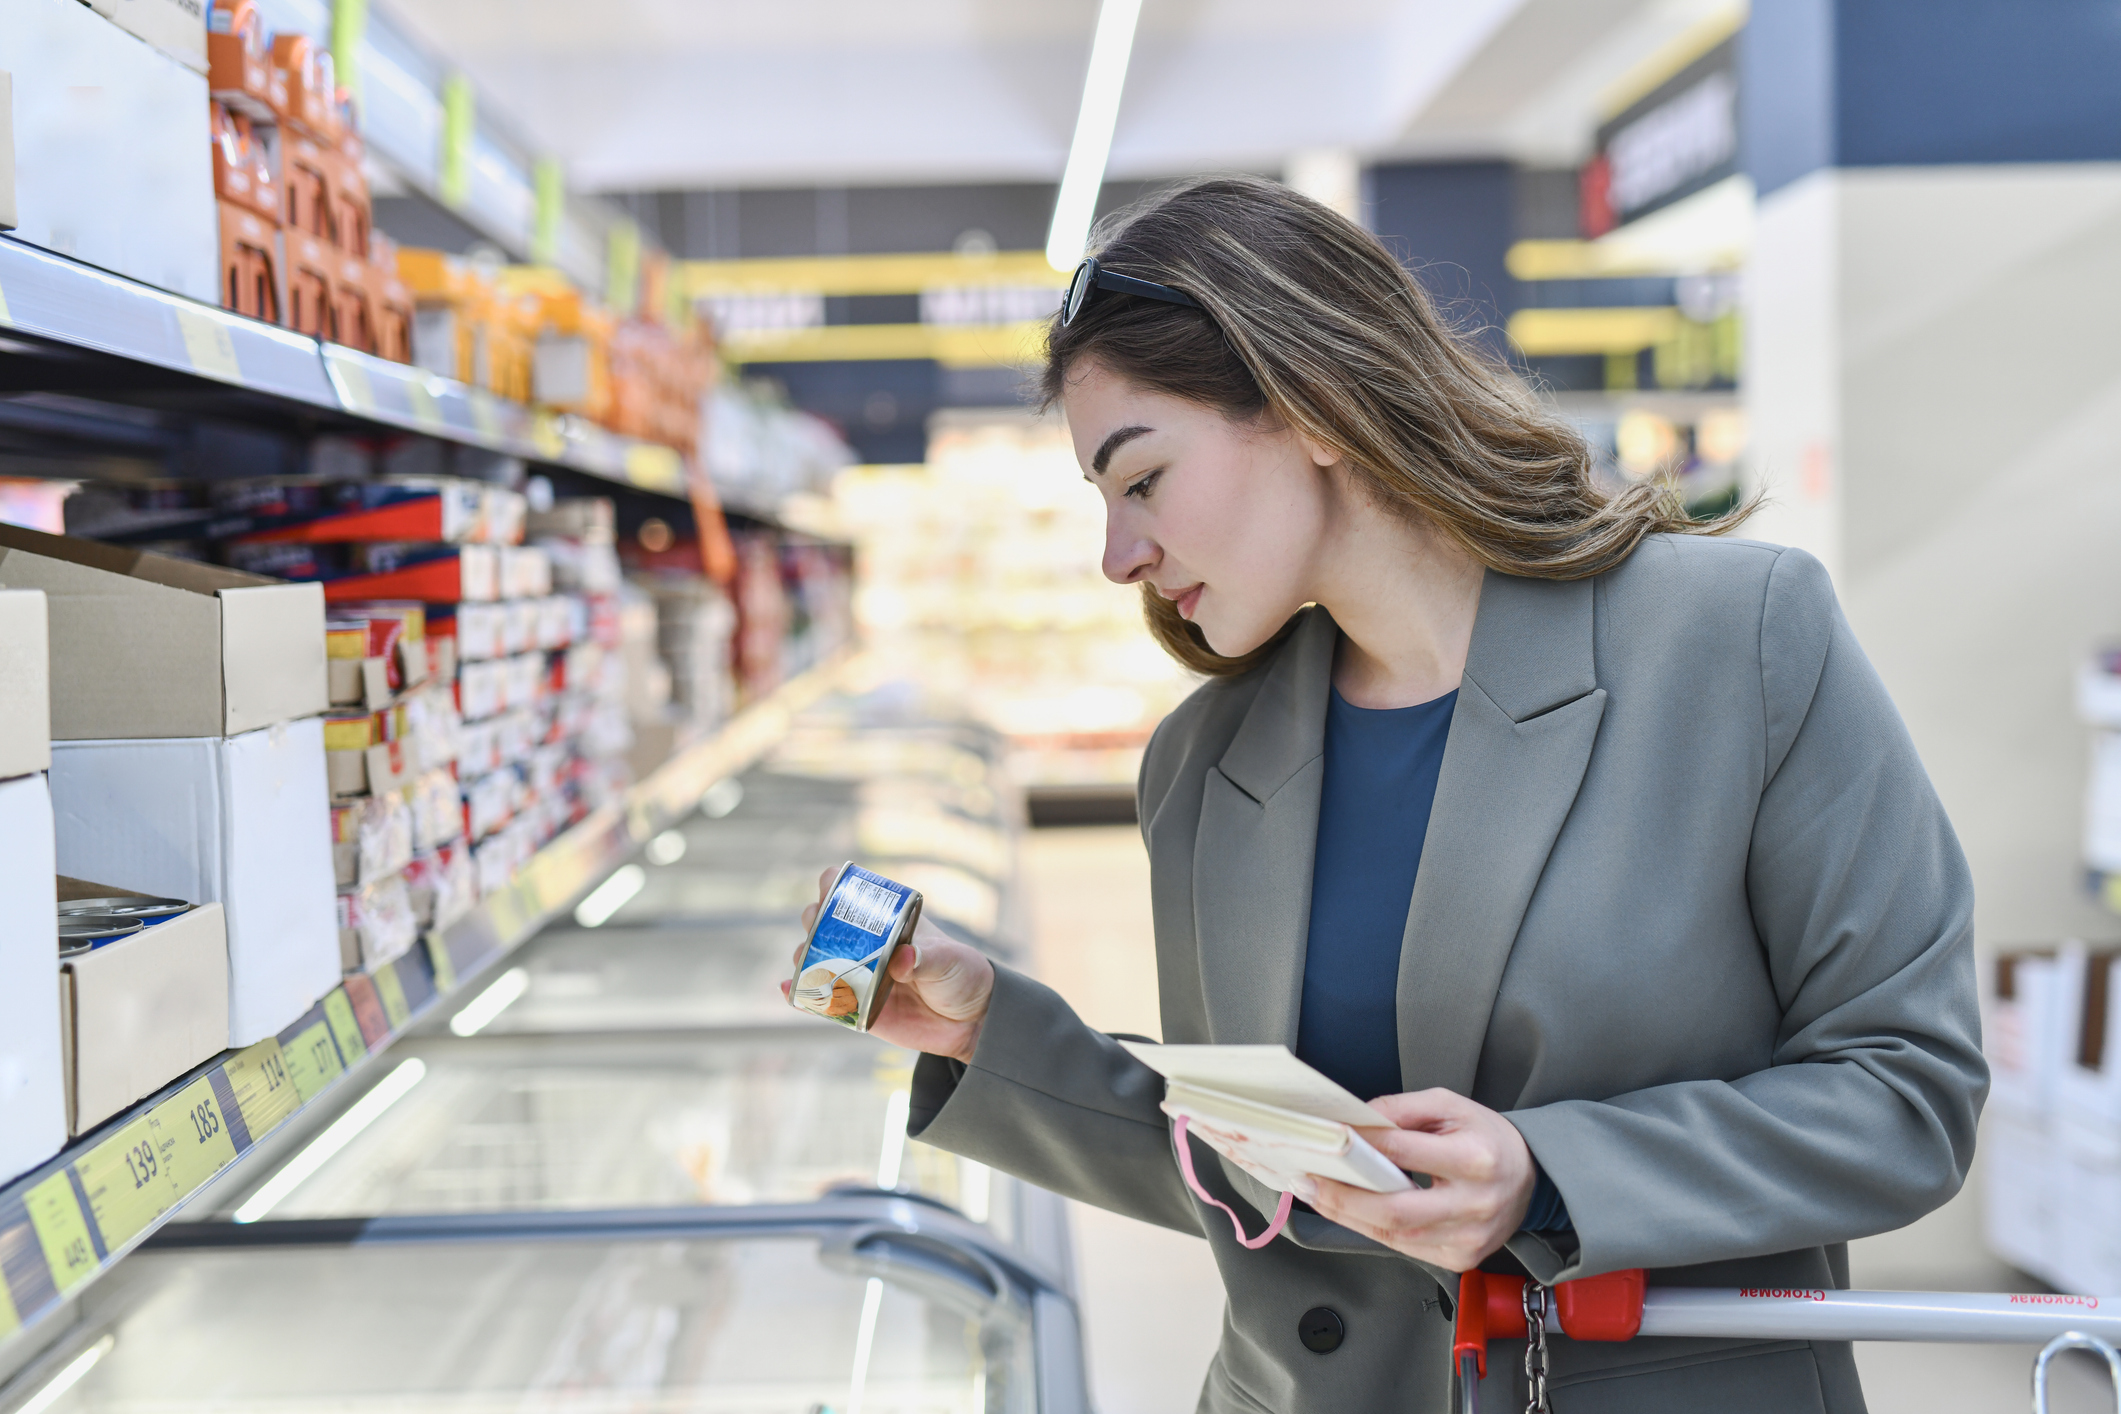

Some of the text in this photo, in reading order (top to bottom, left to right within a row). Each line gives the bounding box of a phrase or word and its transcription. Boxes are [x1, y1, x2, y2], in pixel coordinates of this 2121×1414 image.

[261, 1053, 286, 1092] 114
[190, 1099, 219, 1144] 185
[126, 1140, 157, 1189] 139
[1740, 1288, 1826, 1302] Стокомак
[2010, 1294, 2099, 1310] Стокомак
